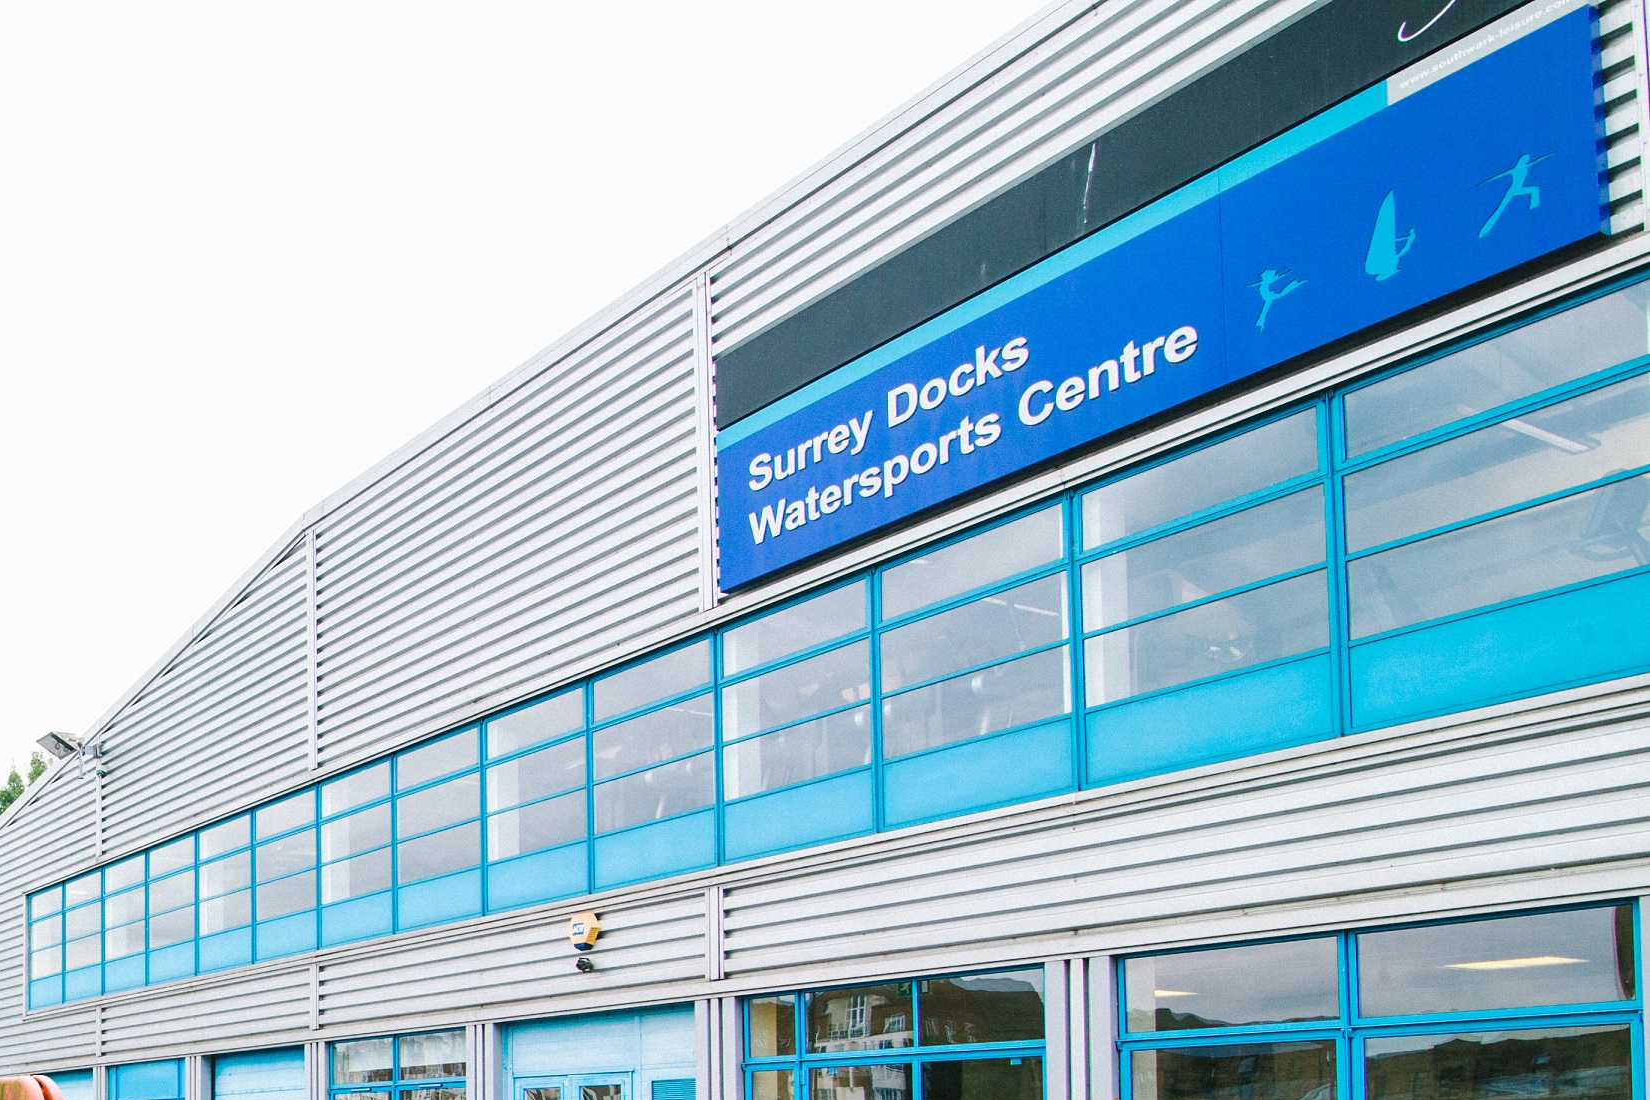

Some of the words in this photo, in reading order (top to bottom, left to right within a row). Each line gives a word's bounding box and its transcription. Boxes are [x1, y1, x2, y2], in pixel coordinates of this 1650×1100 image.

[747, 409, 874, 491] Surrey
[886, 336, 1030, 429] Docks
[748, 412, 1002, 545] Watersports
[1017, 325, 1199, 426] Centre
